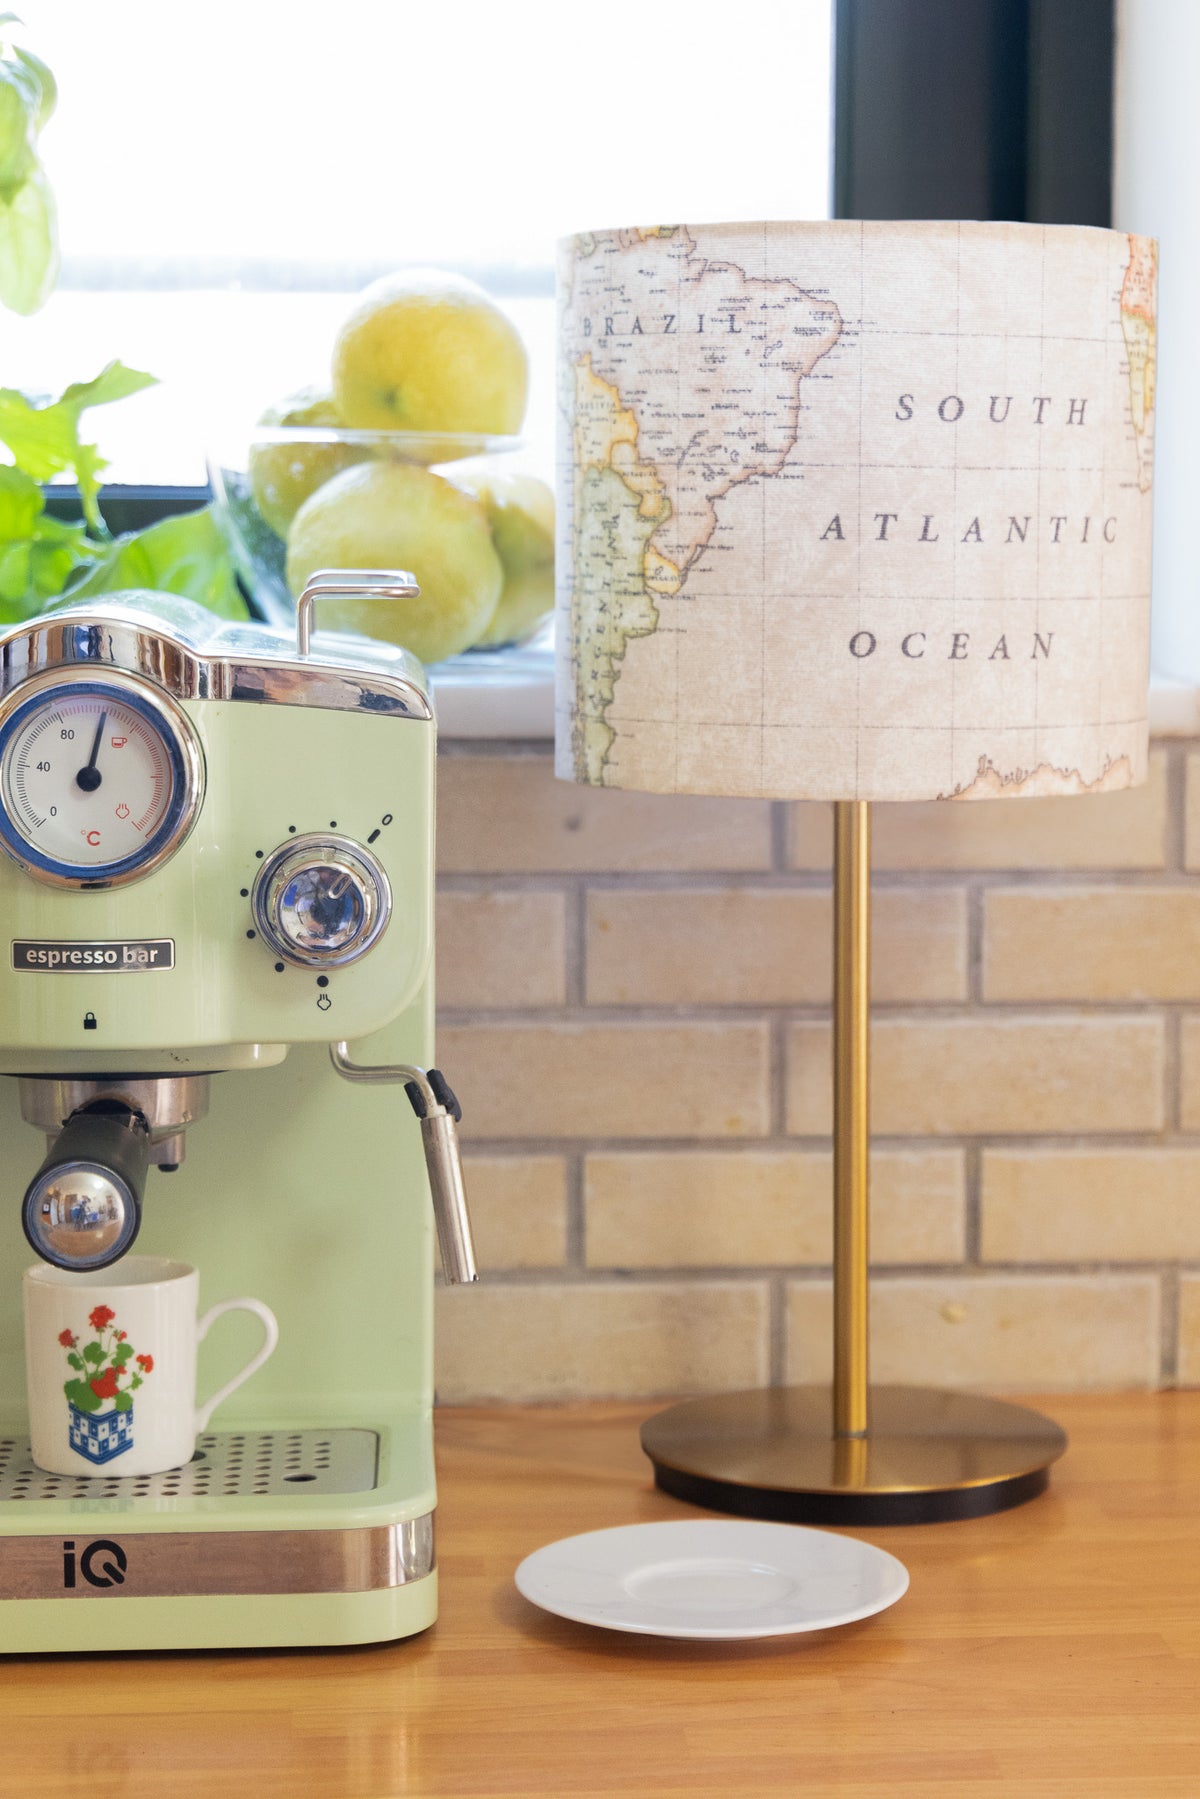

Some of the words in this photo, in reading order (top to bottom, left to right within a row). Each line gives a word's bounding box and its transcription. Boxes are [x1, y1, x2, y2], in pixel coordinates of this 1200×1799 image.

[583, 313, 742, 335] BRAZIL
[895, 393, 1089, 426] SOUTH
[820, 513, 1119, 543] ATLANTIC
[849, 630, 1054, 660] OCEAN
[60, 728, 76, 742] 80
[36, 760, 51, 774] 40
[49, 805, 58, 818] 0
[25, 945, 118, 967] espresso
[123, 943, 159, 965] bar
